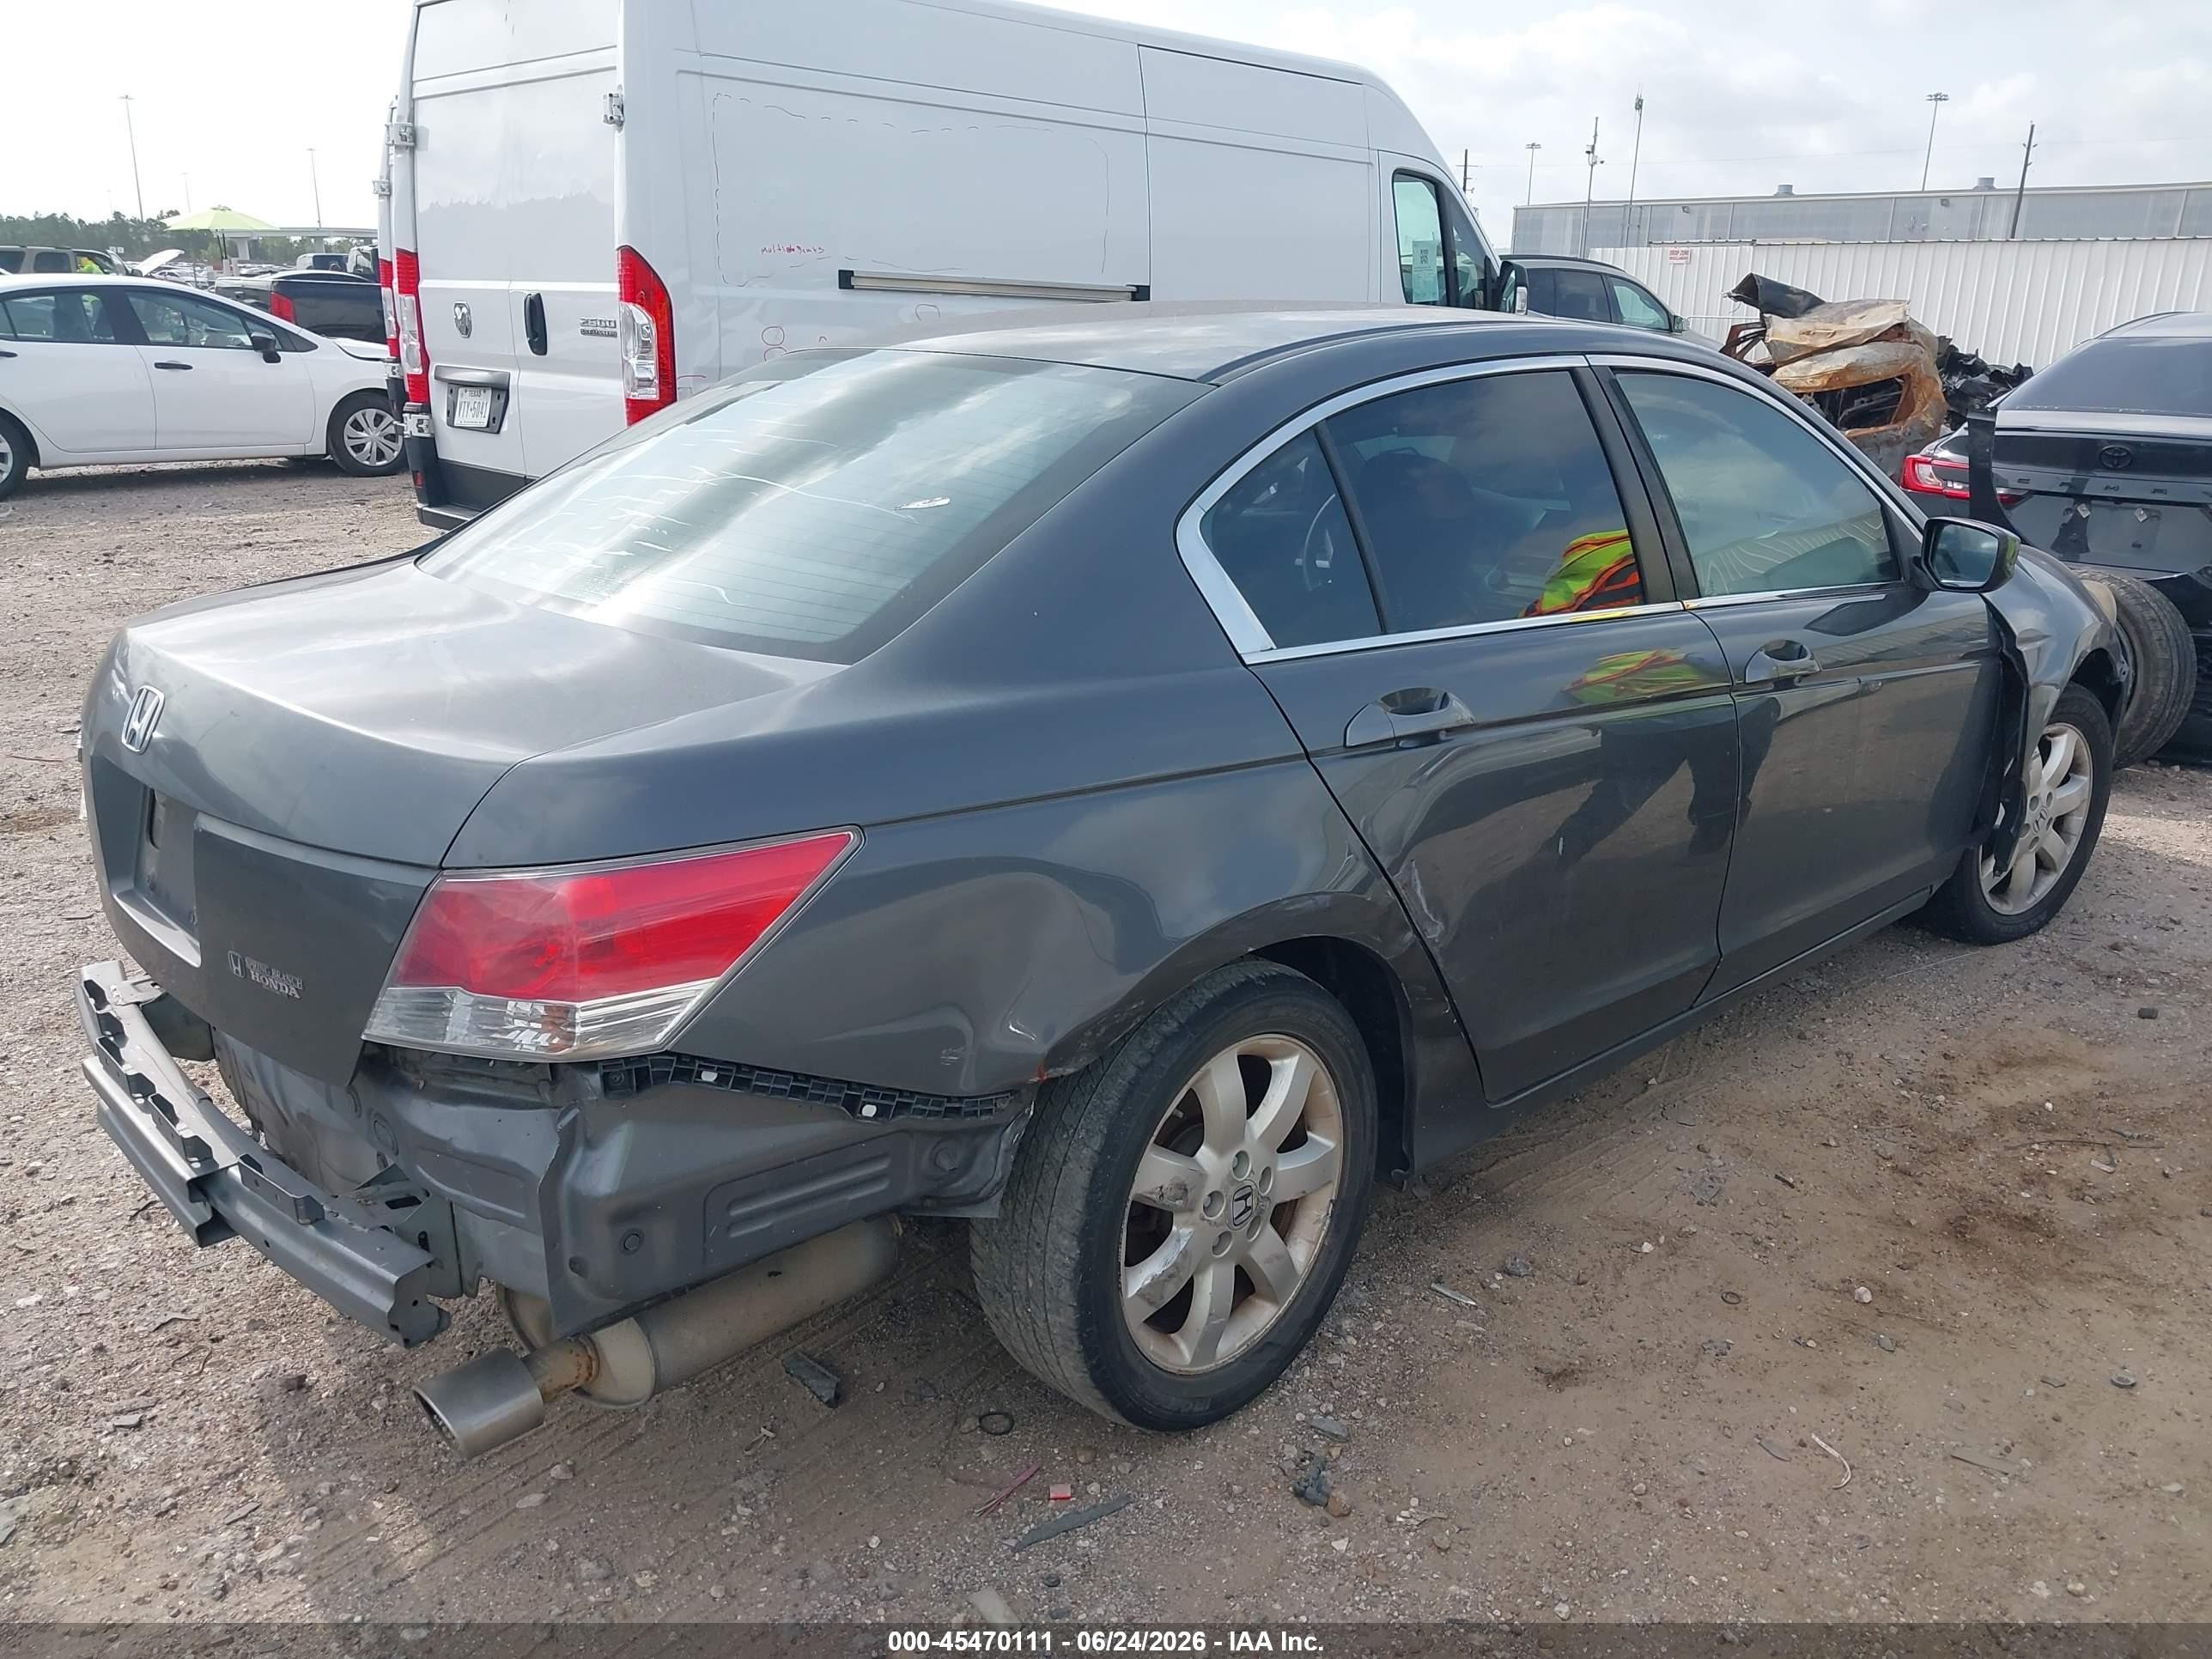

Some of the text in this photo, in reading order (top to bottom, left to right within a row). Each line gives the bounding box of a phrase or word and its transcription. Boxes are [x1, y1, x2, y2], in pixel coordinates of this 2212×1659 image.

[580, 318, 617, 328] 2500
[245, 956, 303, 990] SPRING BRANCH
[250, 969, 301, 999] HONDA
